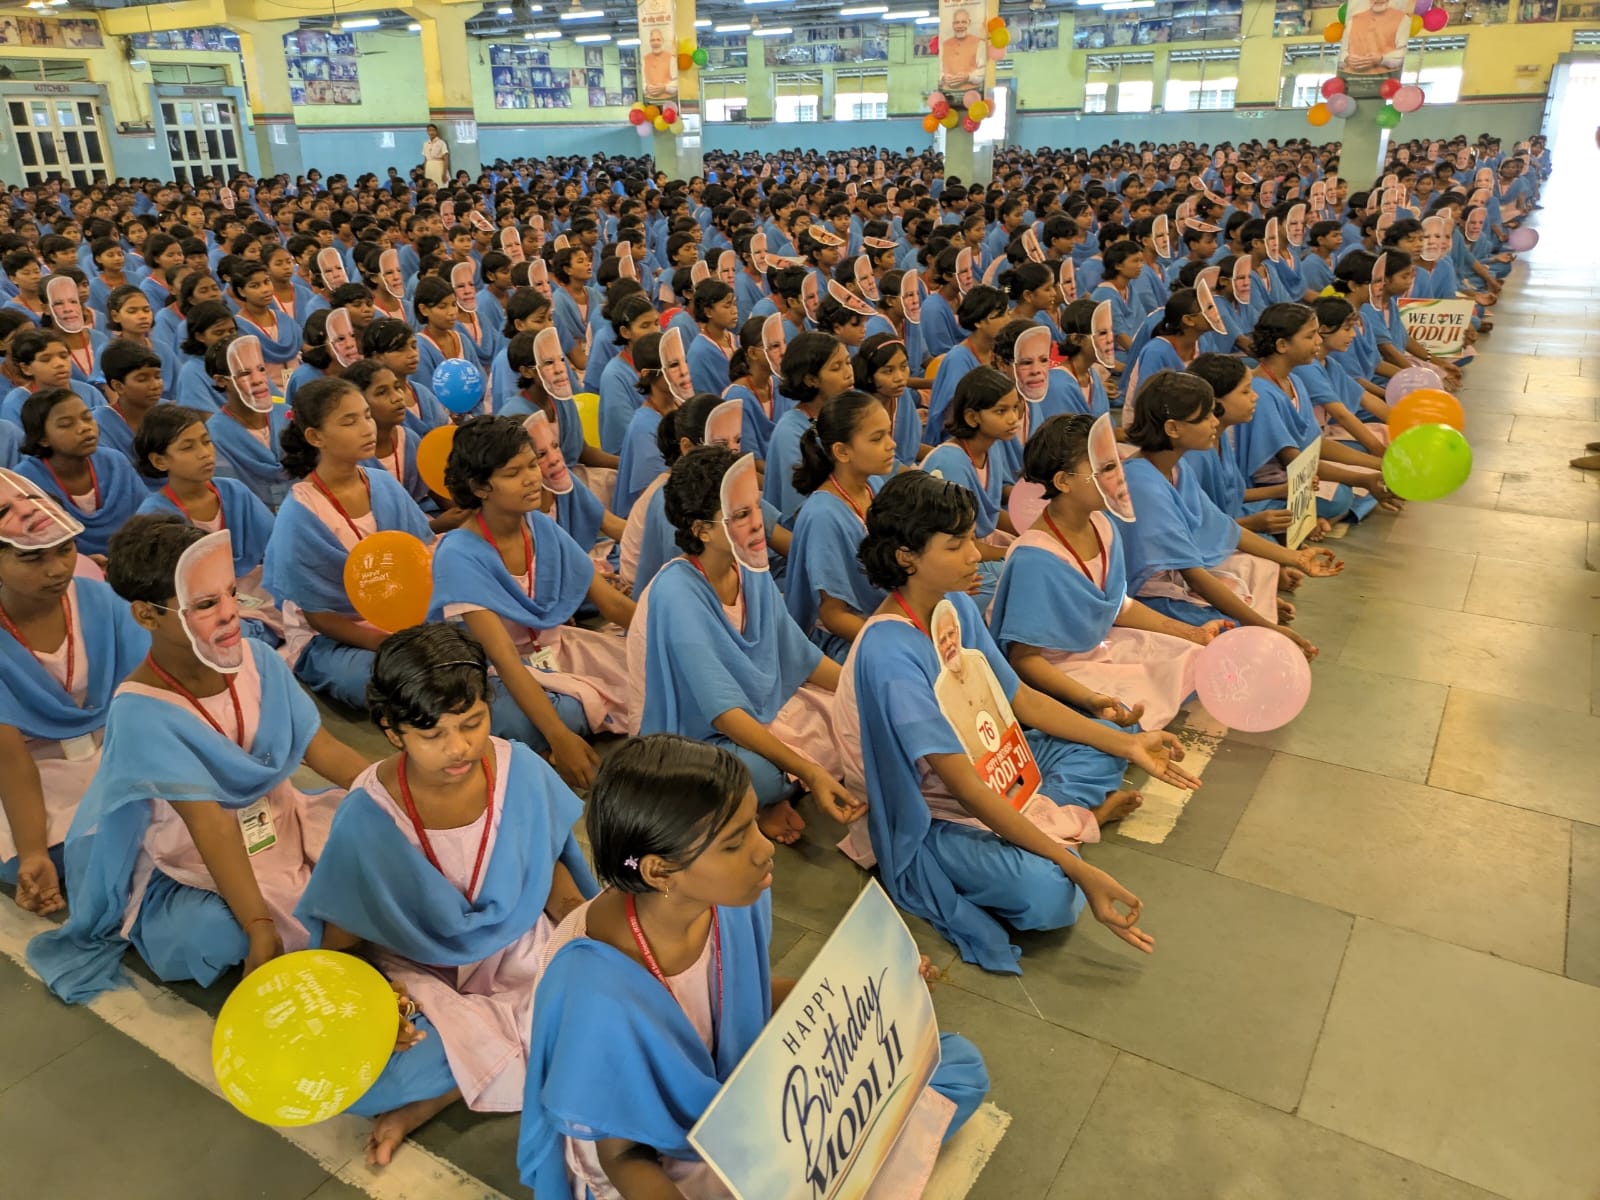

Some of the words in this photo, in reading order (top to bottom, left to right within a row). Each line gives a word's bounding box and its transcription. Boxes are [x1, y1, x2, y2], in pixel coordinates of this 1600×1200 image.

[1408, 312, 1428, 324] WE
[1443, 326, 1461, 344] JI
[782, 977, 835, 1055] HAPPY
[782, 967, 888, 1183] Birthday
[882, 1020, 904, 1089] JI
